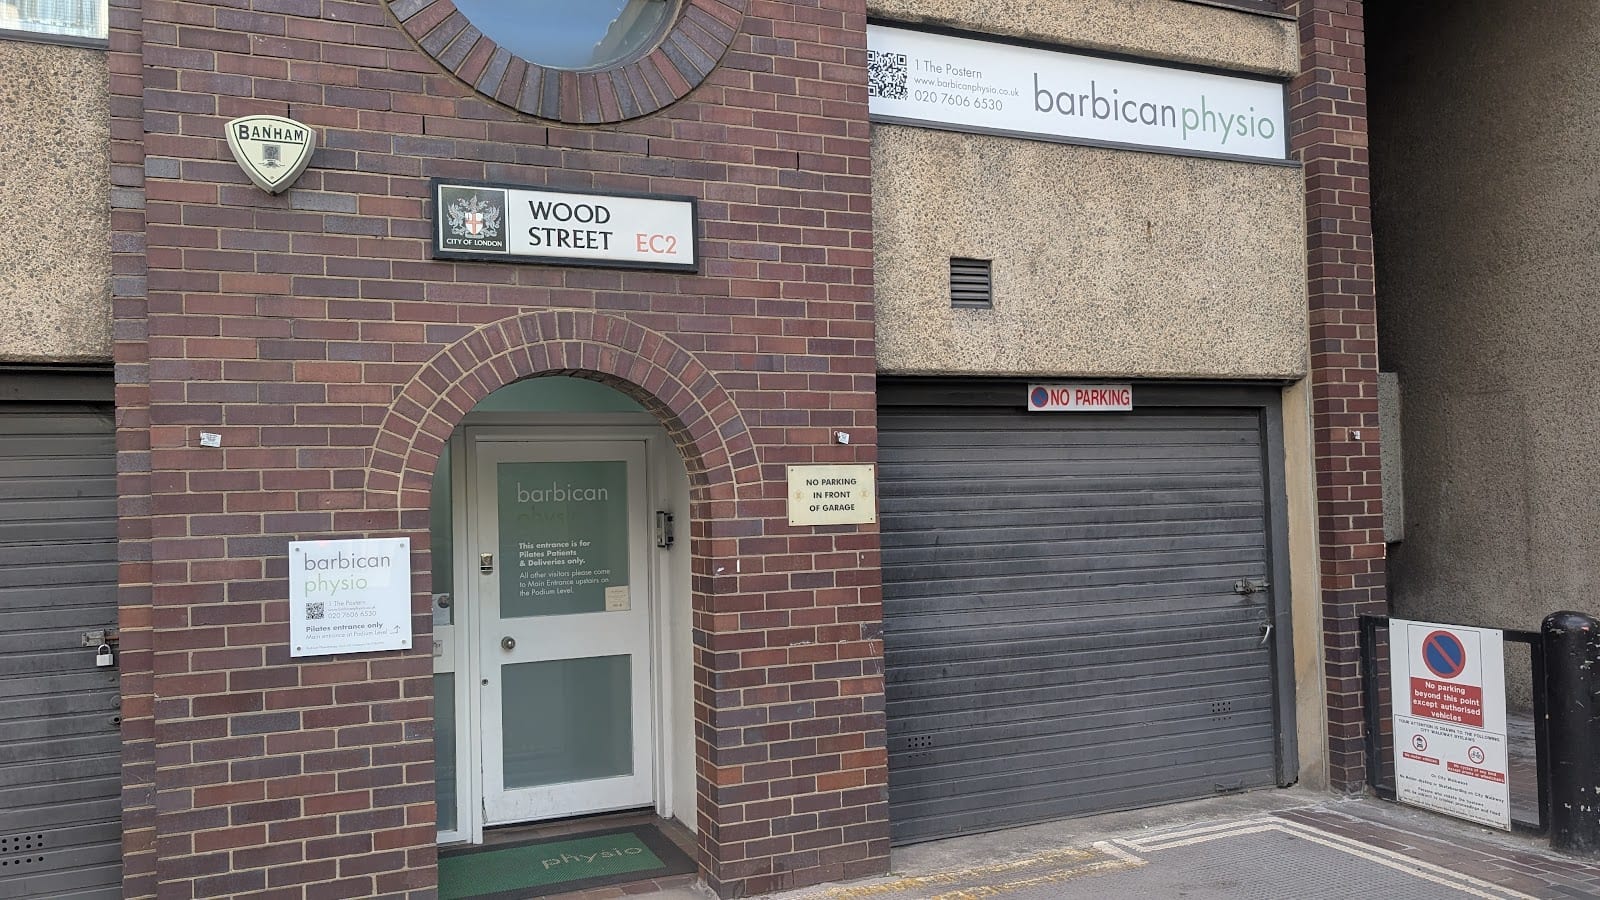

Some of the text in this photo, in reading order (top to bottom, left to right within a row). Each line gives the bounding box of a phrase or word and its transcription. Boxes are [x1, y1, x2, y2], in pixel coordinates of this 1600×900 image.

[914, 59, 982, 79] 1 The Postern
[914, 77, 1020, 96] www.barbicanphysio.co.uk
[914, 90, 1003, 111] 020 7606 6530
[238, 124, 304, 142] BANHAM
[528, 200, 611, 224] WOOD
[474, 240, 503, 248] LONDON
[528, 226, 613, 250] STREET
[636, 233, 677, 254] EC2
[1050, 388, 1130, 406] NO PARKING
[822, 478, 857, 486] PARKING
[517, 480, 608, 502] barbican
[822, 504, 855, 512] GARAGE
[519, 542, 534, 550] This
[536, 541, 569, 549] entrance
[520, 549, 577, 558] Pilates Patients
[304, 551, 390, 571] barbican
[528, 558, 566, 566] Deliveries
[567, 557, 586, 566] only.
[520, 571, 529, 579] All
[530, 570, 546, 578] other
[548, 570, 570, 578] visitors
[572, 568, 592, 578] please
[576, 578, 600, 586] upstairs
[304, 572, 368, 598] physio
[532, 588, 555, 596] Podium
[368, 620, 384, 630] only
[1425, 681, 1466, 695] No parking
[1414, 689, 1480, 706] beyond this point
[1413, 699, 1480, 716] except authorised
[1431, 710, 1462, 722] vehicles
[542, 847, 642, 870] physio
